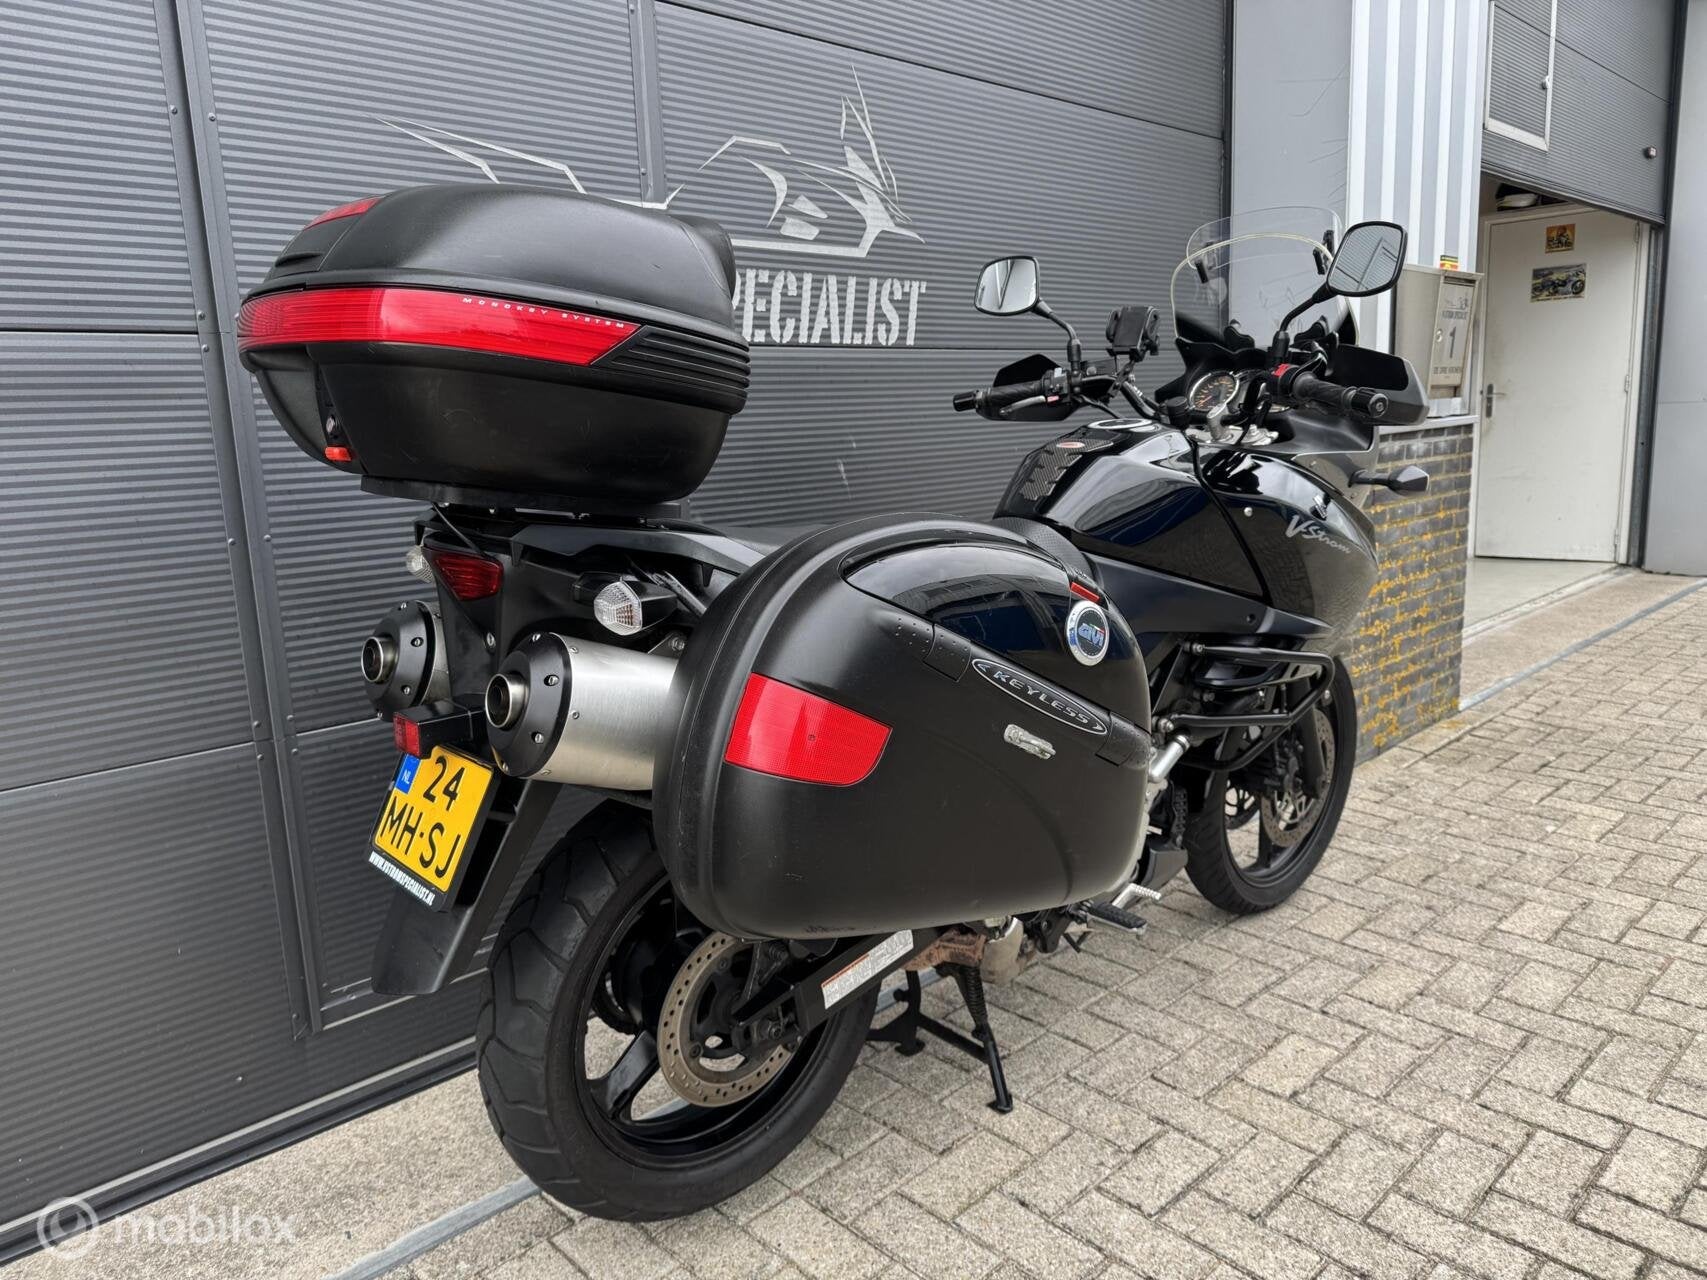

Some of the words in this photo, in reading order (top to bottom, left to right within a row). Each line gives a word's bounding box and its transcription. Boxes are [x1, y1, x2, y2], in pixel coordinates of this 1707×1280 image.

[993, 670, 1091, 725] KEYLESS
[402, 771, 412, 785] NL
[423, 755, 466, 812] 24
